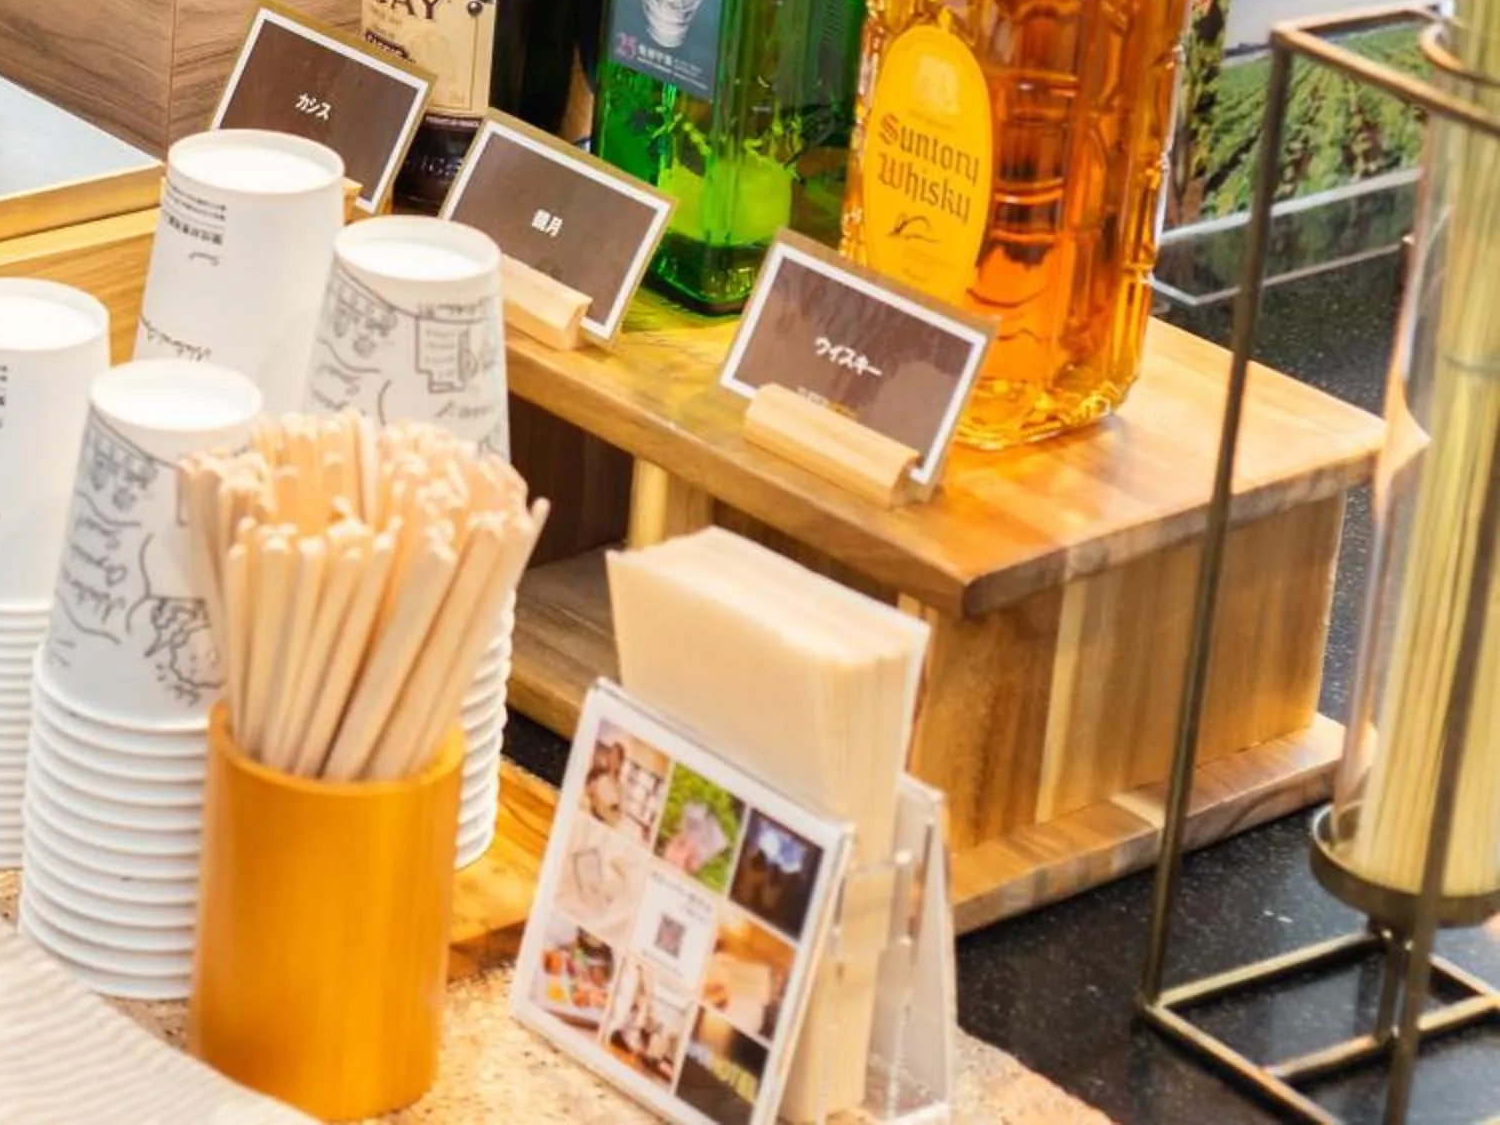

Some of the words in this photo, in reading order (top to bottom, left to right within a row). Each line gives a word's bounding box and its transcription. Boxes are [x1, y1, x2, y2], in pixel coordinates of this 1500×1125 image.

[295, 93, 331, 121] カシス
[878, 112, 980, 188] Suntory
[877, 152, 971, 225] Whisky
[814, 335, 883, 377] ウイスキー
